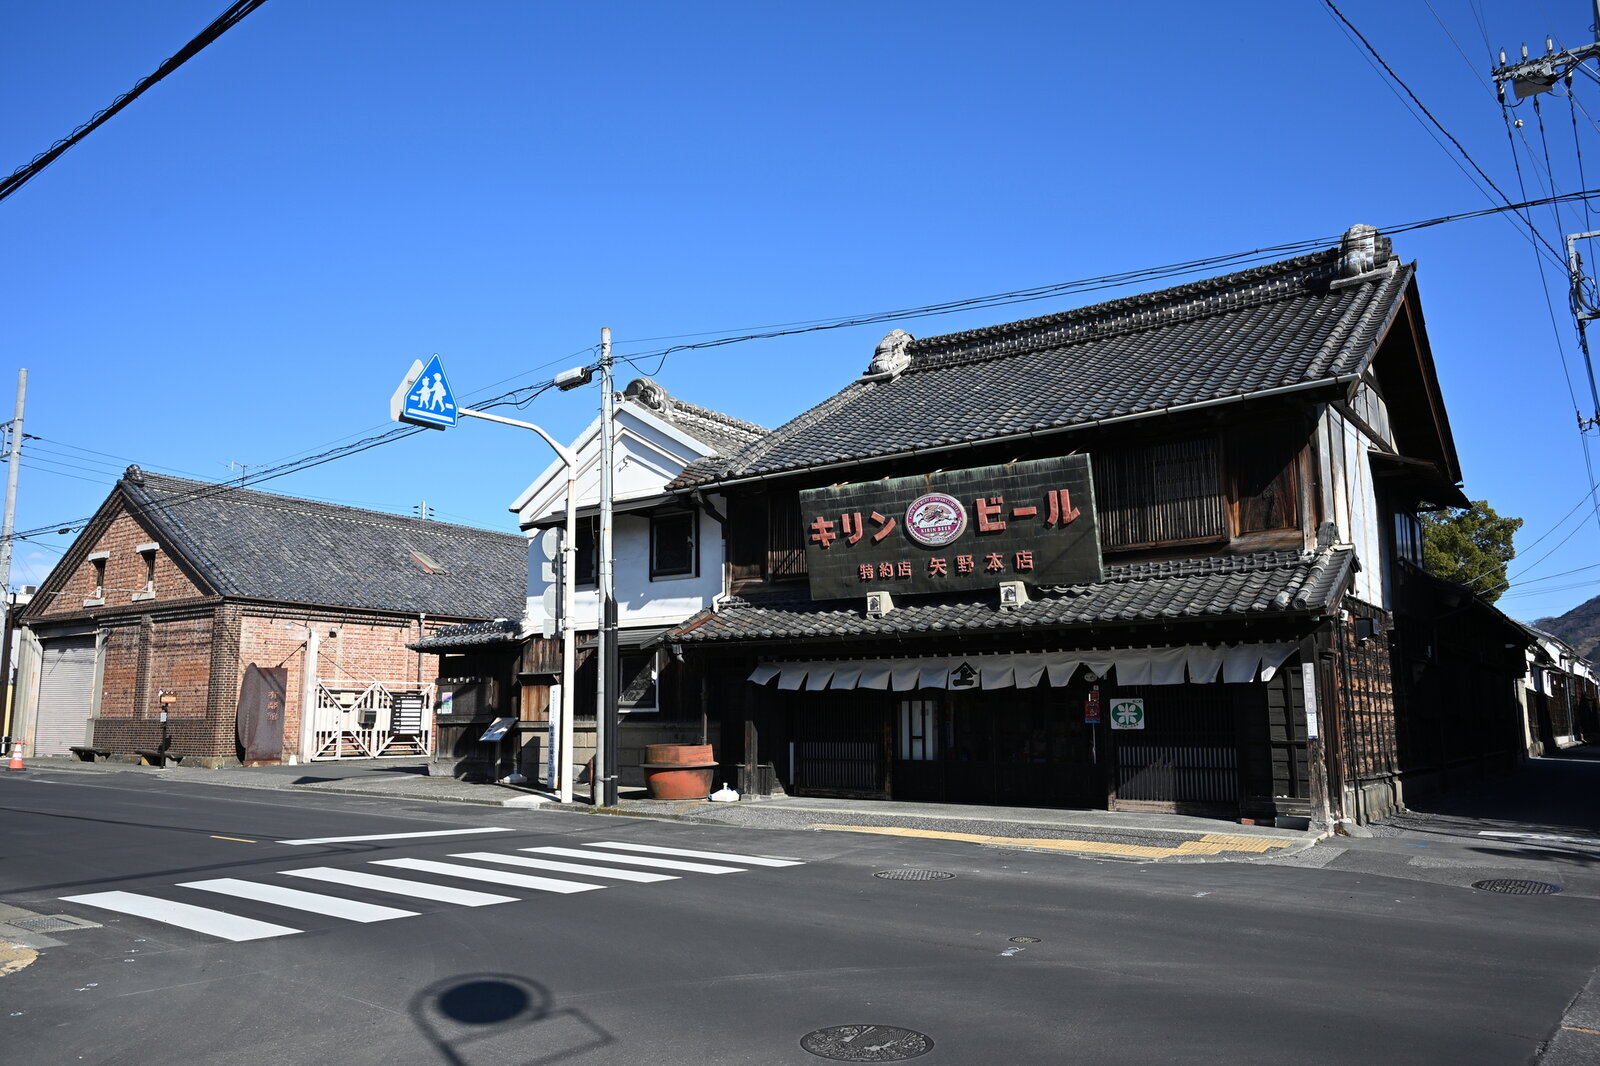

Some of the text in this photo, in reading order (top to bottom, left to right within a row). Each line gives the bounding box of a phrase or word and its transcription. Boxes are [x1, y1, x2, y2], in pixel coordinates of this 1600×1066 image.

[810, 489, 1081, 547] キリン ビール
[859, 551, 1035, 580] 特約店 矢野本店
